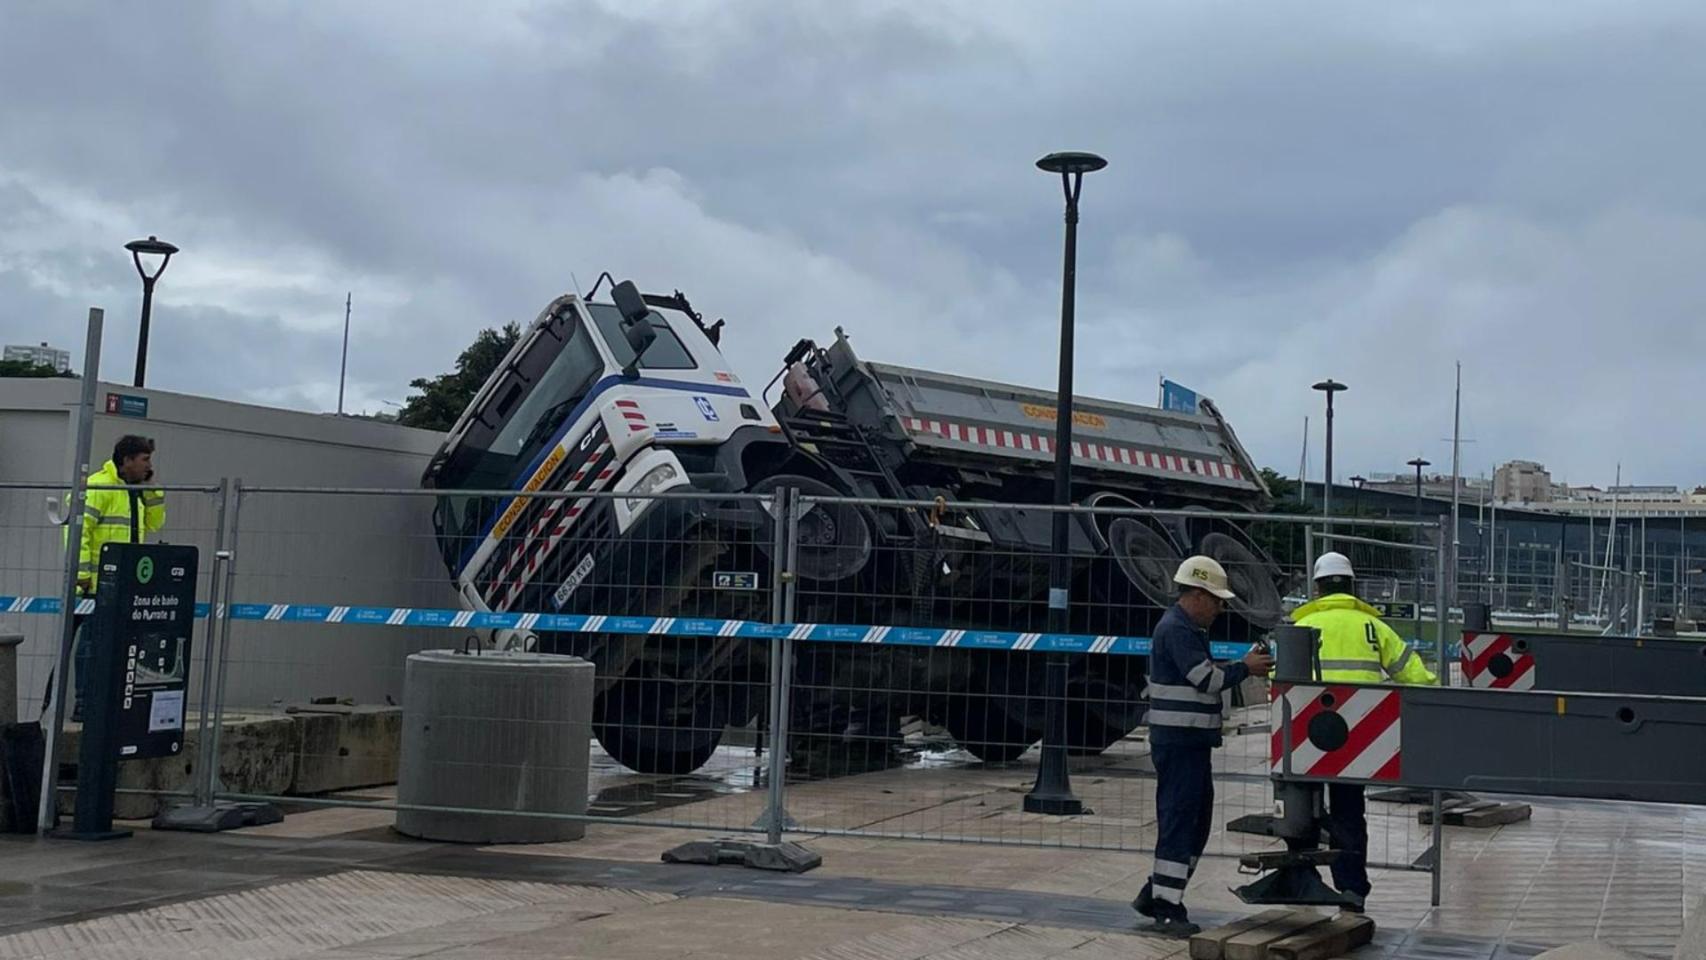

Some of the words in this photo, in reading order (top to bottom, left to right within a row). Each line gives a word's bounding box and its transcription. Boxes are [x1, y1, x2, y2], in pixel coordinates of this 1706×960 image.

[1192, 568, 1209, 581] RS
[557, 575, 577, 601] 6630
[133, 595, 151, 606] Zona
[152, 595, 160, 606] de
[132, 609, 142, 620] do
